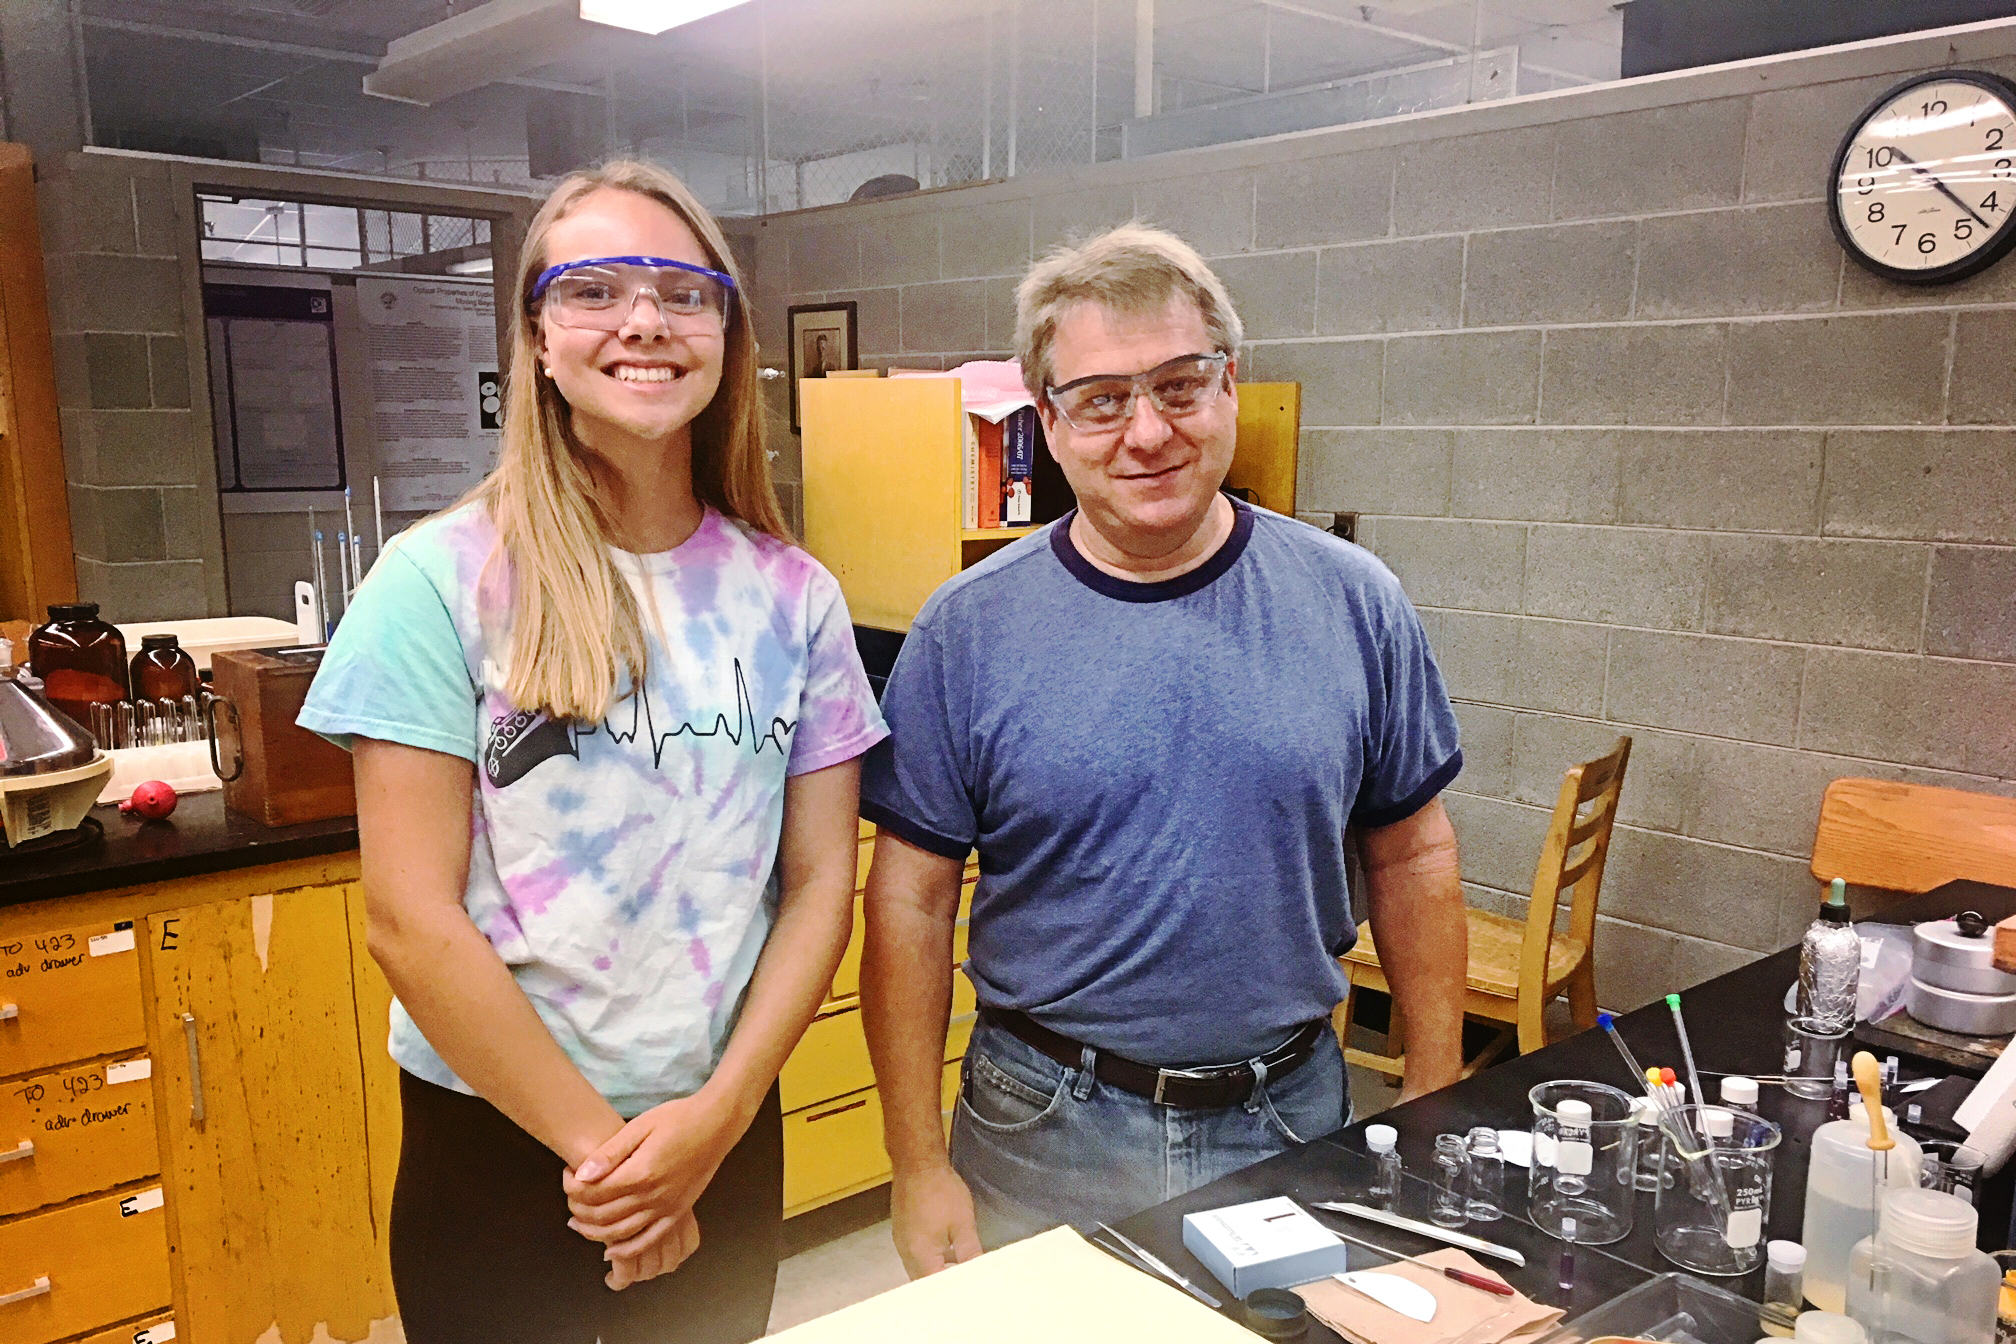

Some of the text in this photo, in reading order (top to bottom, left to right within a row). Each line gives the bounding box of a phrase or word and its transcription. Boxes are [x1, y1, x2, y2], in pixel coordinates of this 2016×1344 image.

[1985, 128, 2004, 151] 2
[1866, 146, 1893, 169] 10
[1979, 190, 1999, 212] 4
[1867, 202, 1885, 223] 8
[1891, 223, 1907, 246] 7
[1953, 218, 1973, 240] 5
[1917, 232, 1937, 254] 6
[469, 289, 475, 297] of
[35, 933, 76, 954] 423
[160, 918, 180, 951] E
[40, 953, 85, 972] drawer
[13, 1074, 104, 1104] TO 423
[120, 1196, 138, 1217] E
